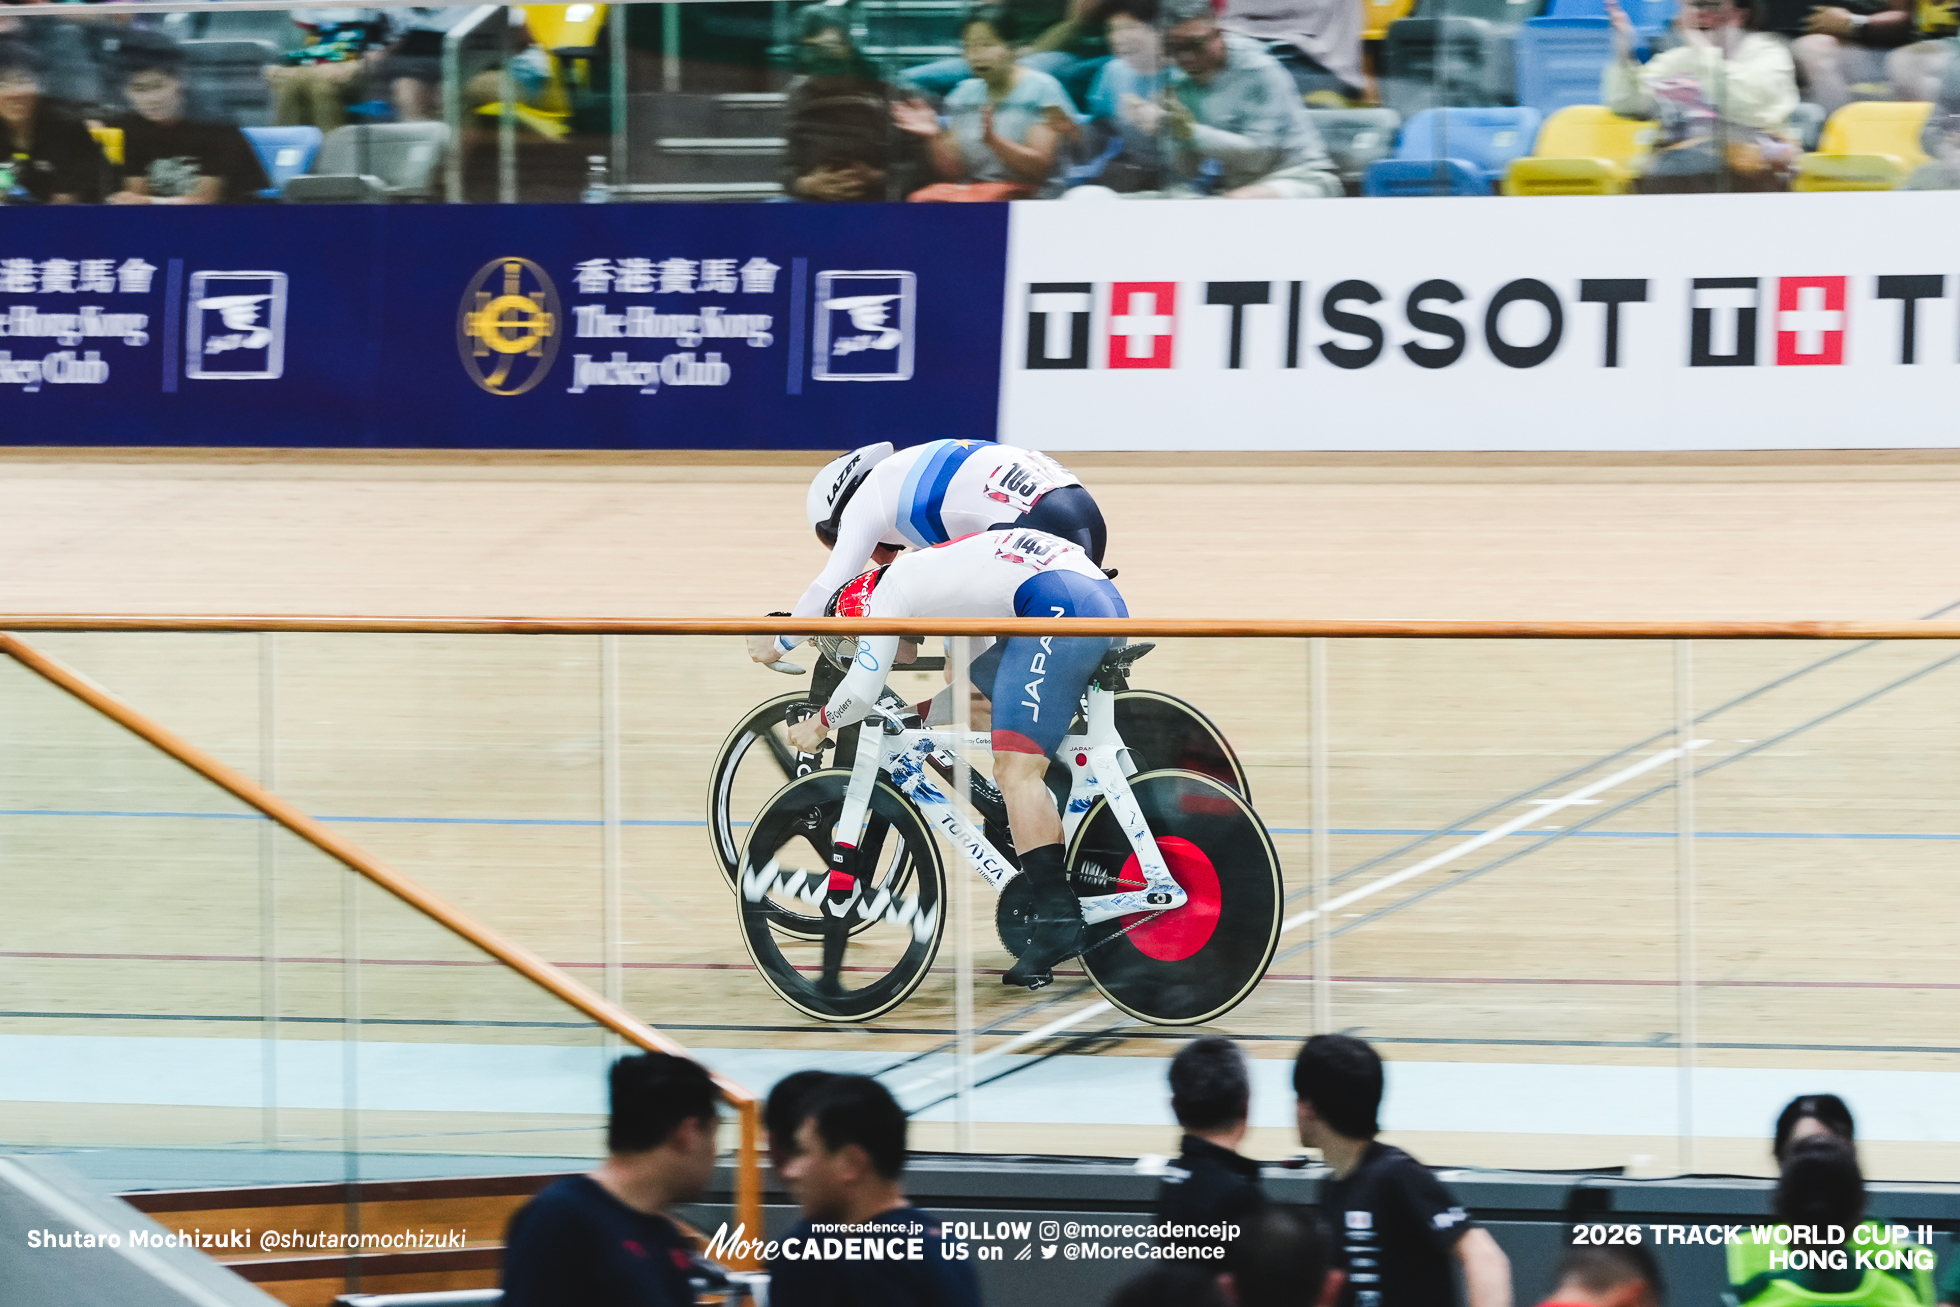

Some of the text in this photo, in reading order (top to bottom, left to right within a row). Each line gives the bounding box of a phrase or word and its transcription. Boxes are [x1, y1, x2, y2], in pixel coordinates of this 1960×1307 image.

[572, 257, 782, 293] 香港賽馬會
[1205, 278, 1649, 370] TISSOT
[826, 453, 861, 507] LAZER
